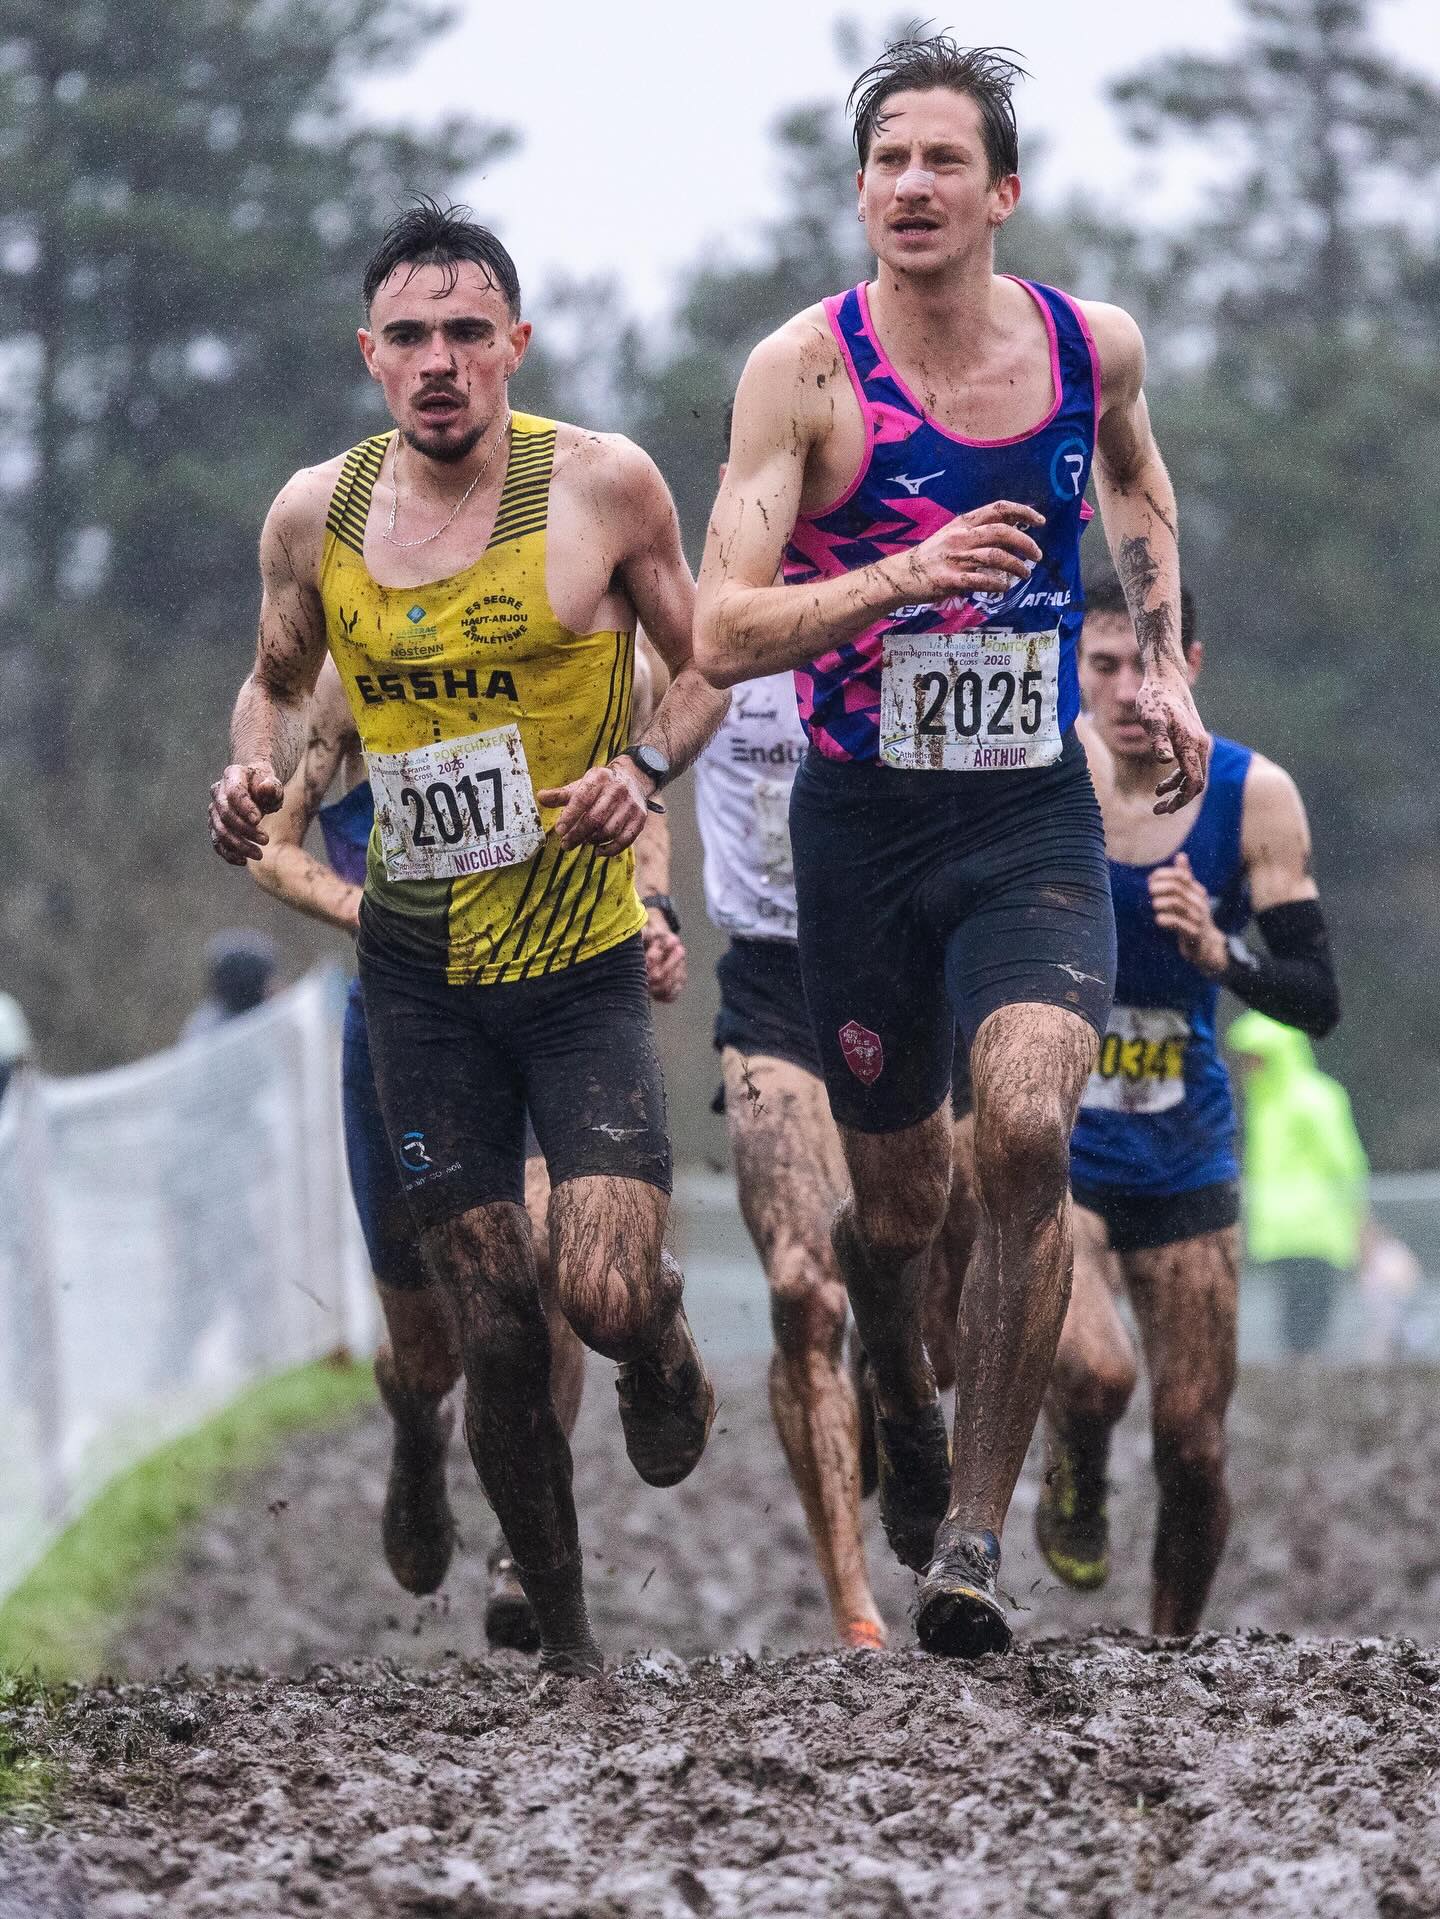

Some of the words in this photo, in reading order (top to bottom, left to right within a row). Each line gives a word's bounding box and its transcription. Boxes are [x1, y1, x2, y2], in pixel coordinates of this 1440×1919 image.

[464, 601, 481, 616] ES
[461, 613, 528, 627] HAUT-ANJOU
[983, 655, 1011, 666] 2026
[355, 669, 519, 704] ESSHA
[918, 671, 1043, 737] 2025
[437, 759, 465, 775] 2026
[973, 747, 1027, 768] ARTHUR
[401, 767, 506, 846] 2017
[454, 841, 516, 873] NICOLAS
